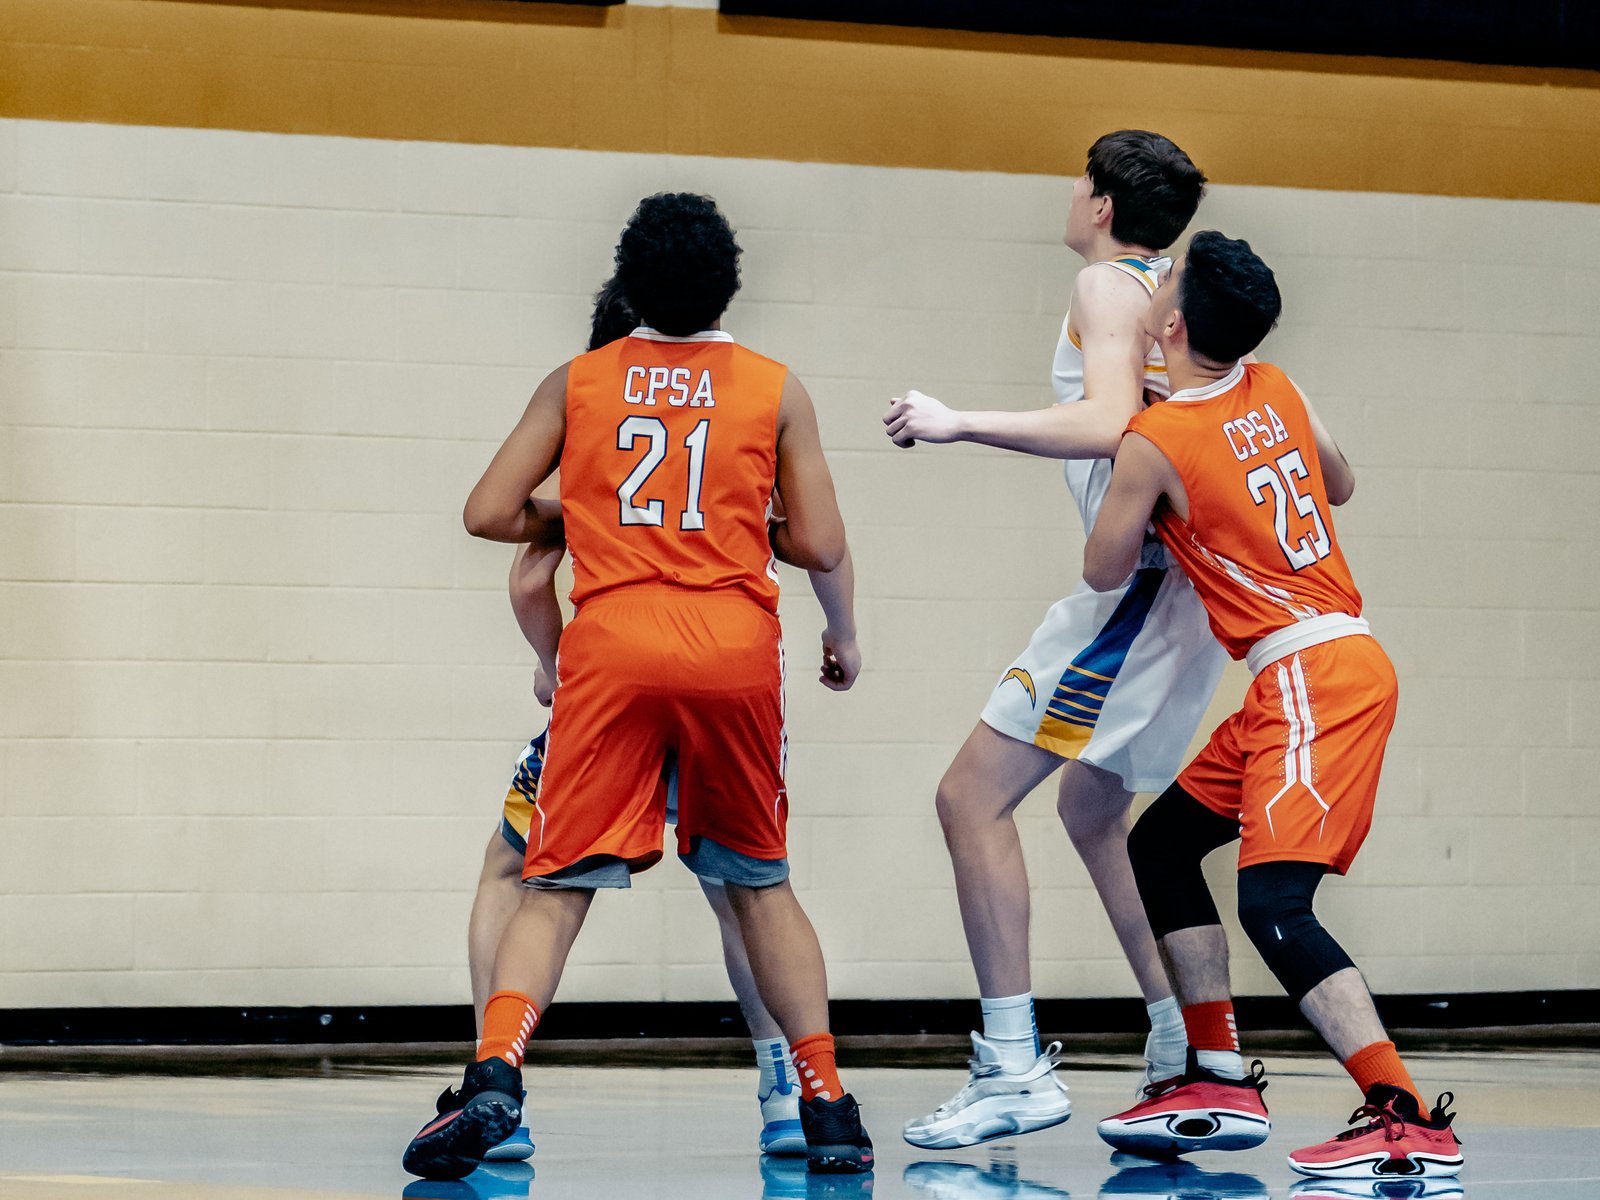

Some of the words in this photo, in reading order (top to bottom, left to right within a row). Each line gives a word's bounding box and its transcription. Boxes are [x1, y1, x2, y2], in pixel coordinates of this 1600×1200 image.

[624, 365, 715, 408] CPSA
[616, 414, 710, 531] 21
[1222, 403, 1289, 462] CPSA
[1246, 448, 1331, 572] 25
